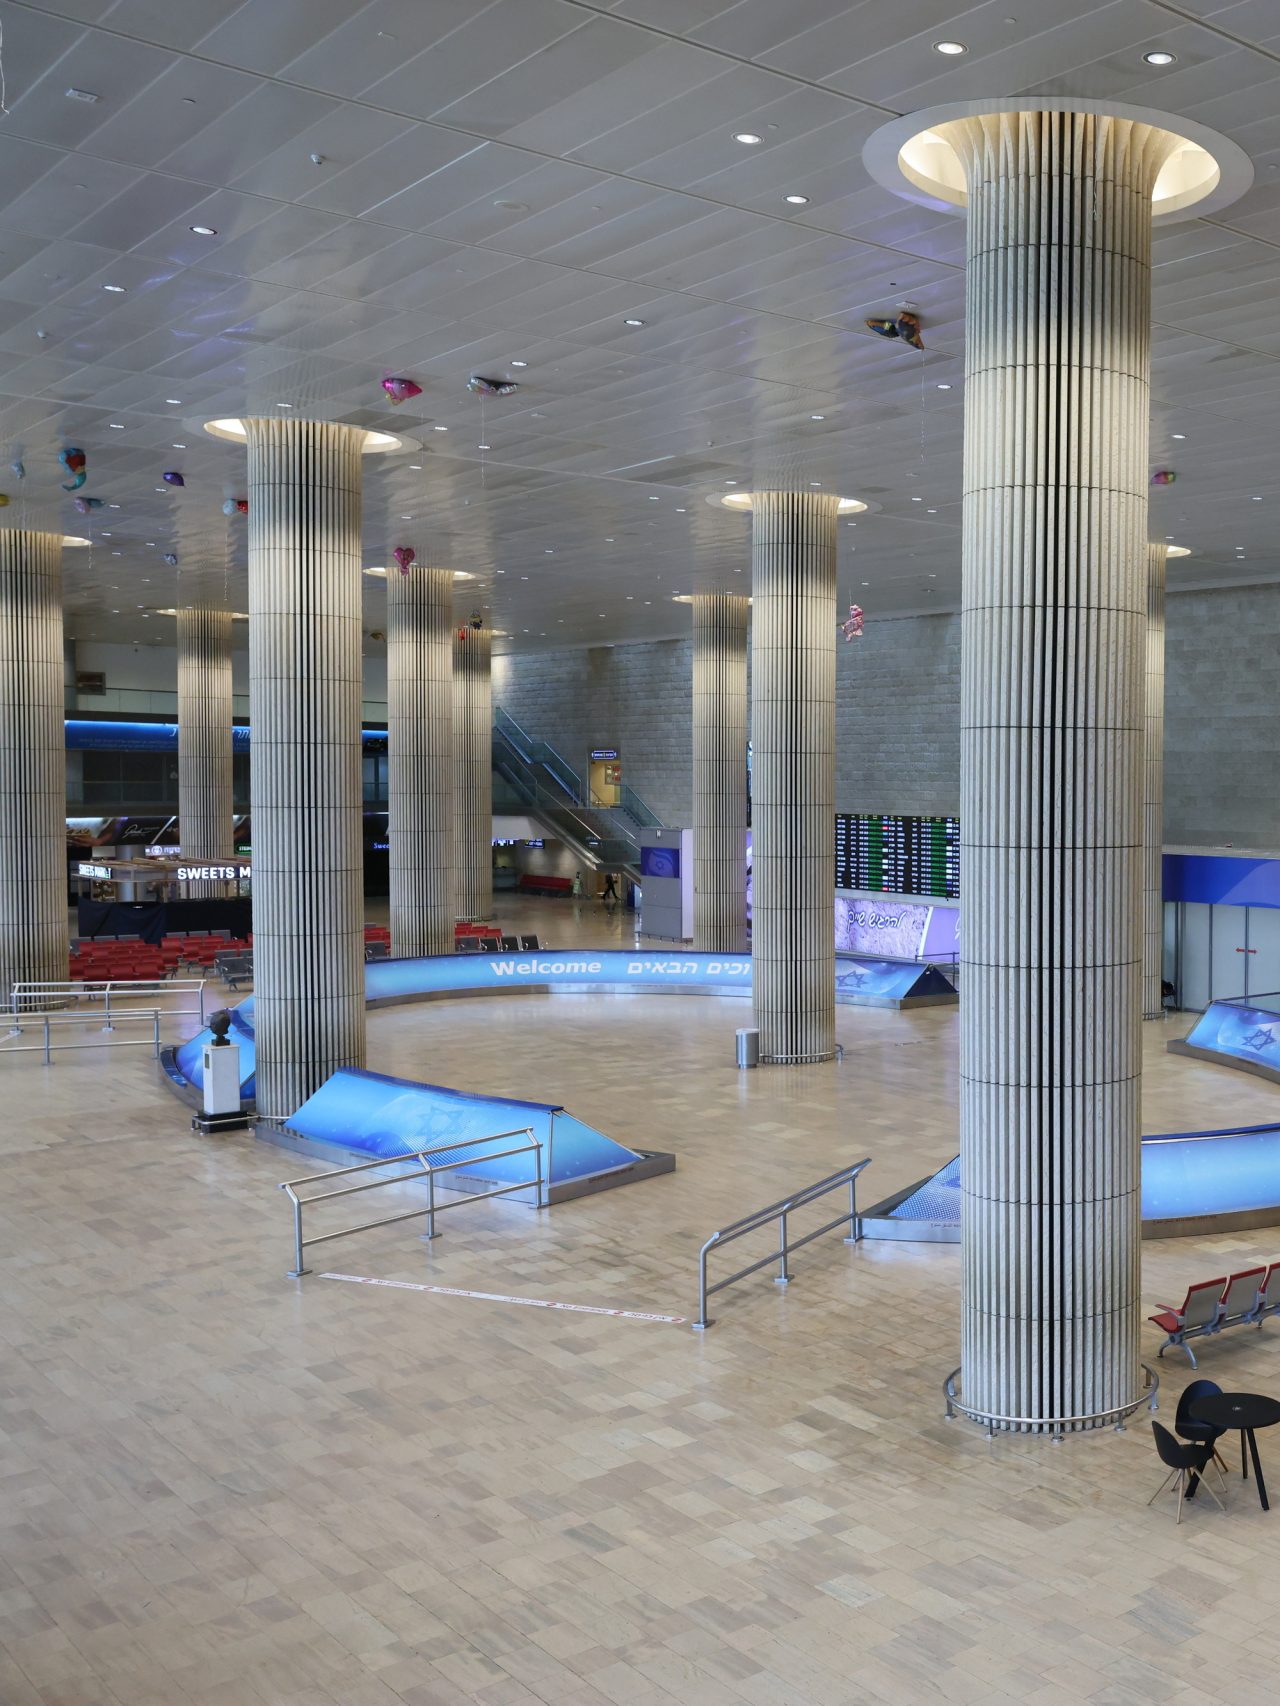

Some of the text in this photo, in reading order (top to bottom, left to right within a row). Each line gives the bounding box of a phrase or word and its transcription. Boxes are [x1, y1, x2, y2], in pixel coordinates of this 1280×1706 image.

[177, 867, 235, 880] SWEETS
[490, 960, 602, 976] Welcome
[627, 961, 698, 975] הבאים
